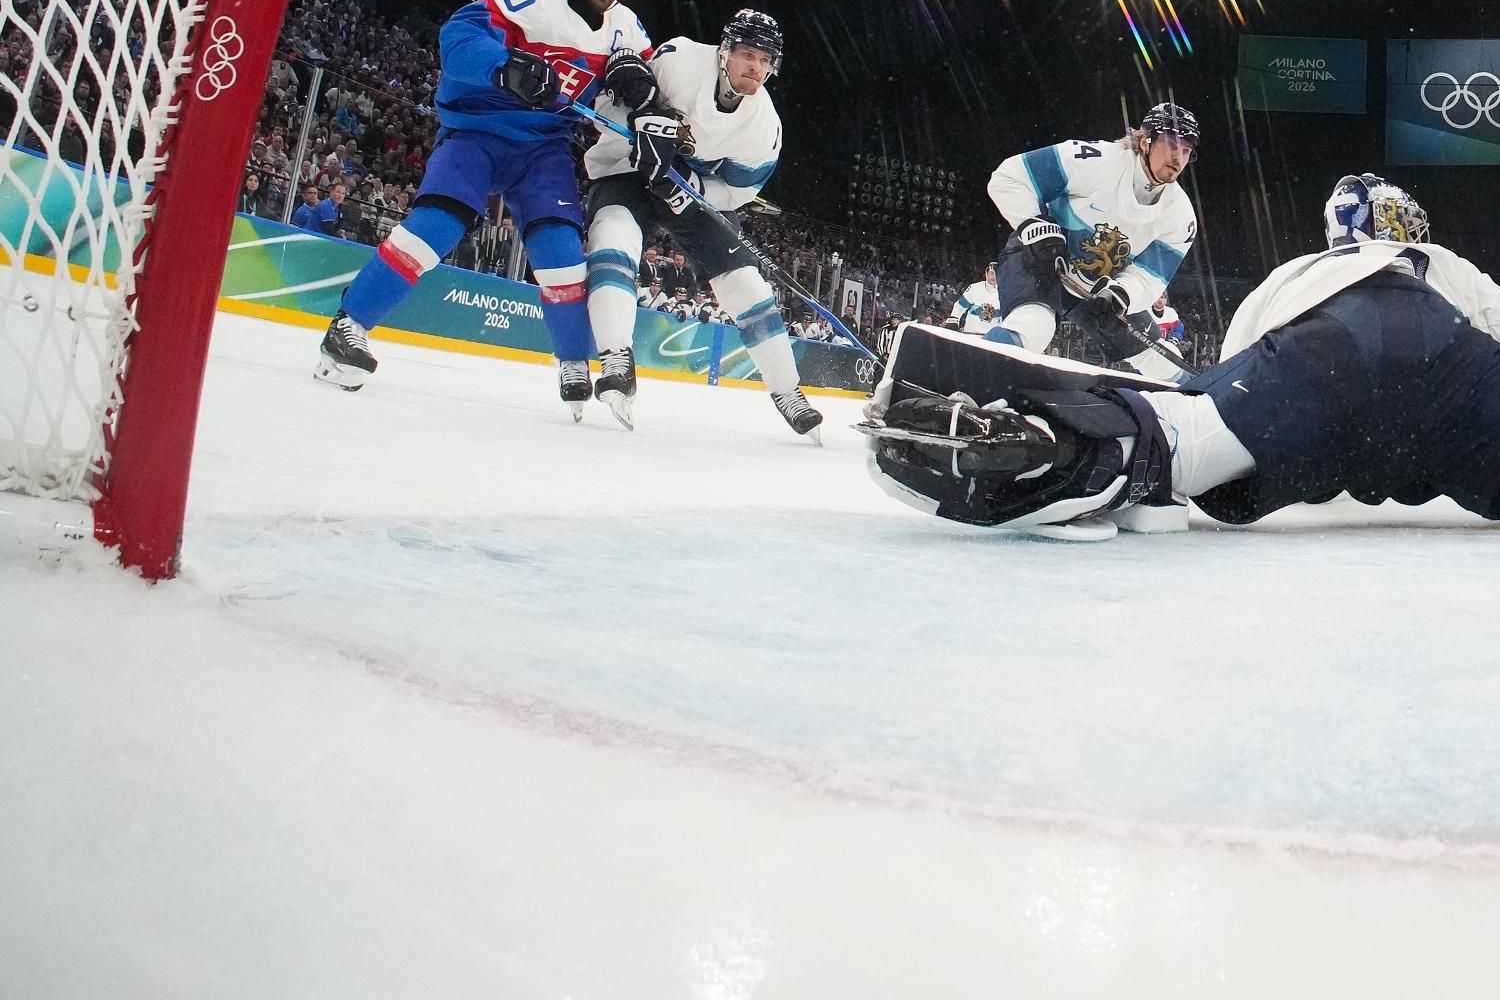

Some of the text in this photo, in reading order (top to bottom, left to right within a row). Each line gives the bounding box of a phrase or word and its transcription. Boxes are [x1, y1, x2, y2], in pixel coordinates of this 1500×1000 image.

[1267, 57, 1326, 69] MILANO
[1277, 69, 1337, 81] CORTINA
[1287, 81, 1316, 92] 2026
[642, 121, 677, 137] CC
[443, 288, 544, 320] MILANO CORTIN
[484, 312, 510, 329] 2026
